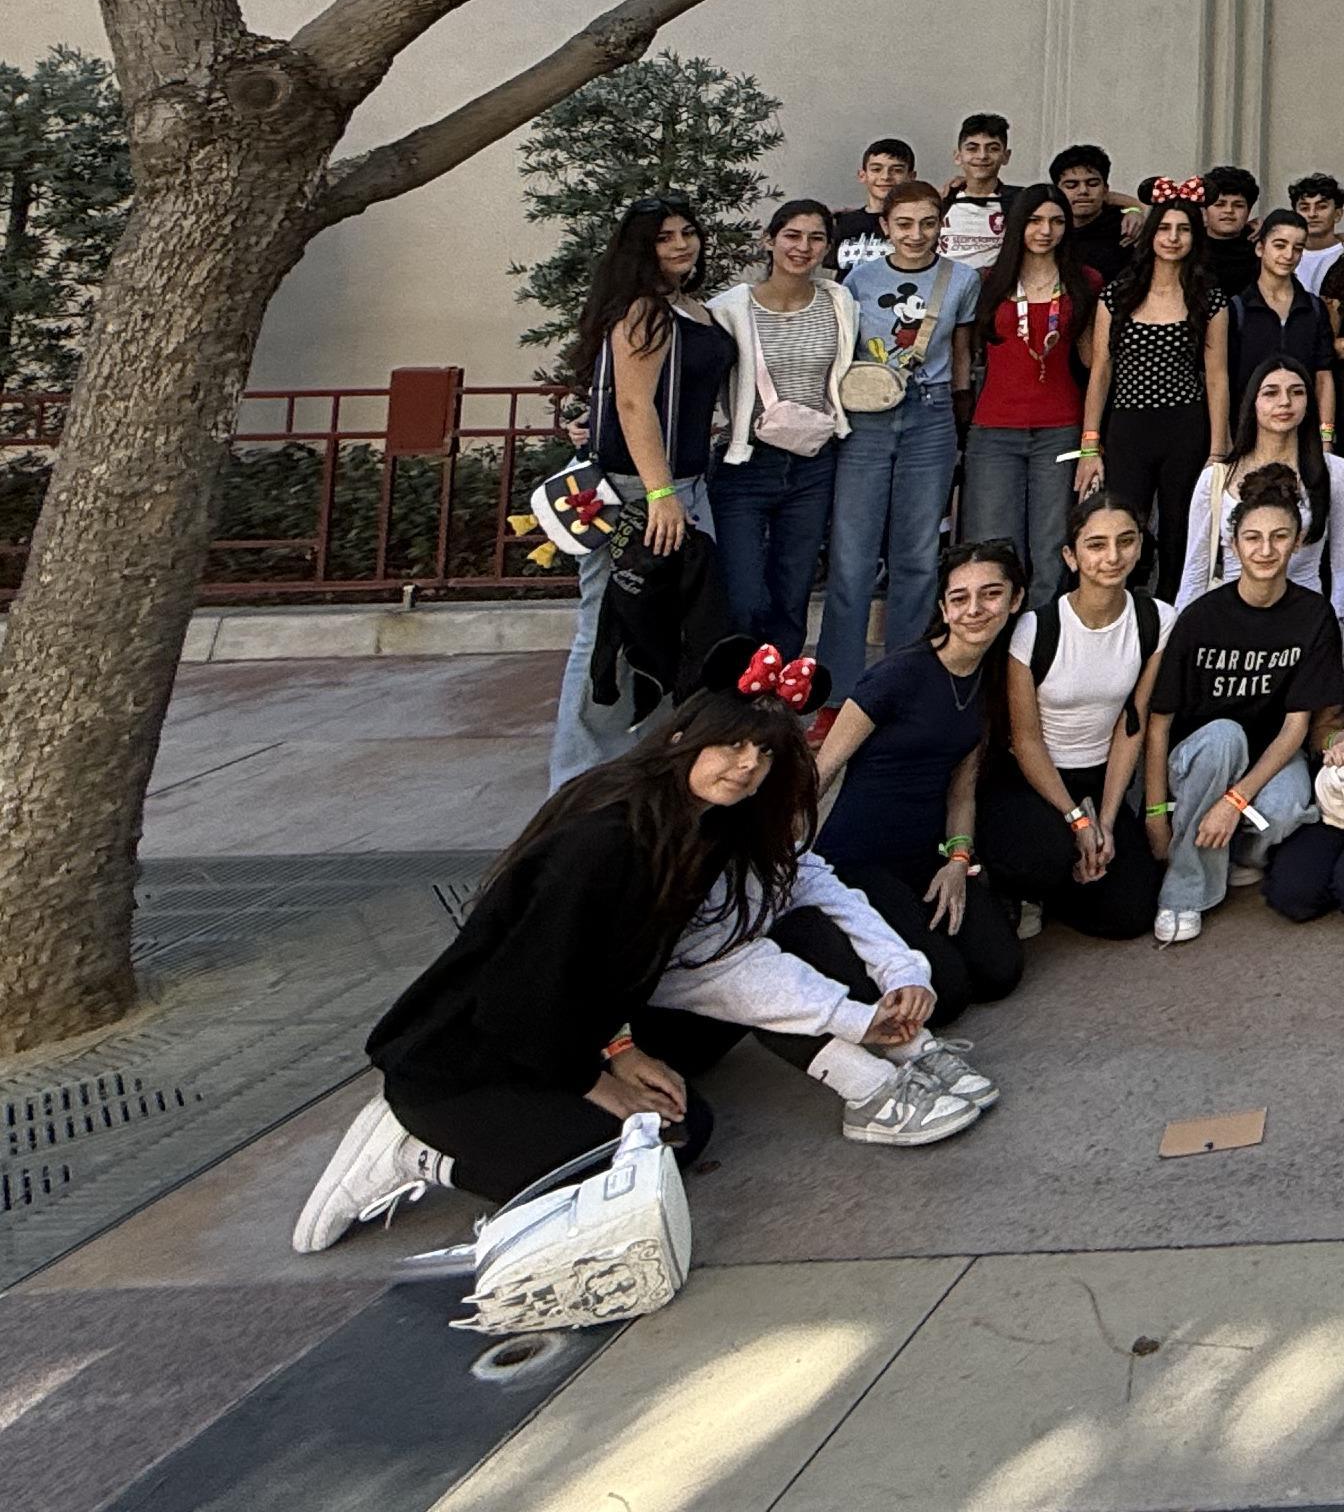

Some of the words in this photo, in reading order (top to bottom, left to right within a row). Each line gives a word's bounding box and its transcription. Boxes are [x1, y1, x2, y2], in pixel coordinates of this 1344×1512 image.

[1196, 647, 1240, 670] FEAR
[1244, 650, 1268, 671] OF
[1268, 647, 1301, 669] GOD
[1212, 674, 1272, 698] STATE
